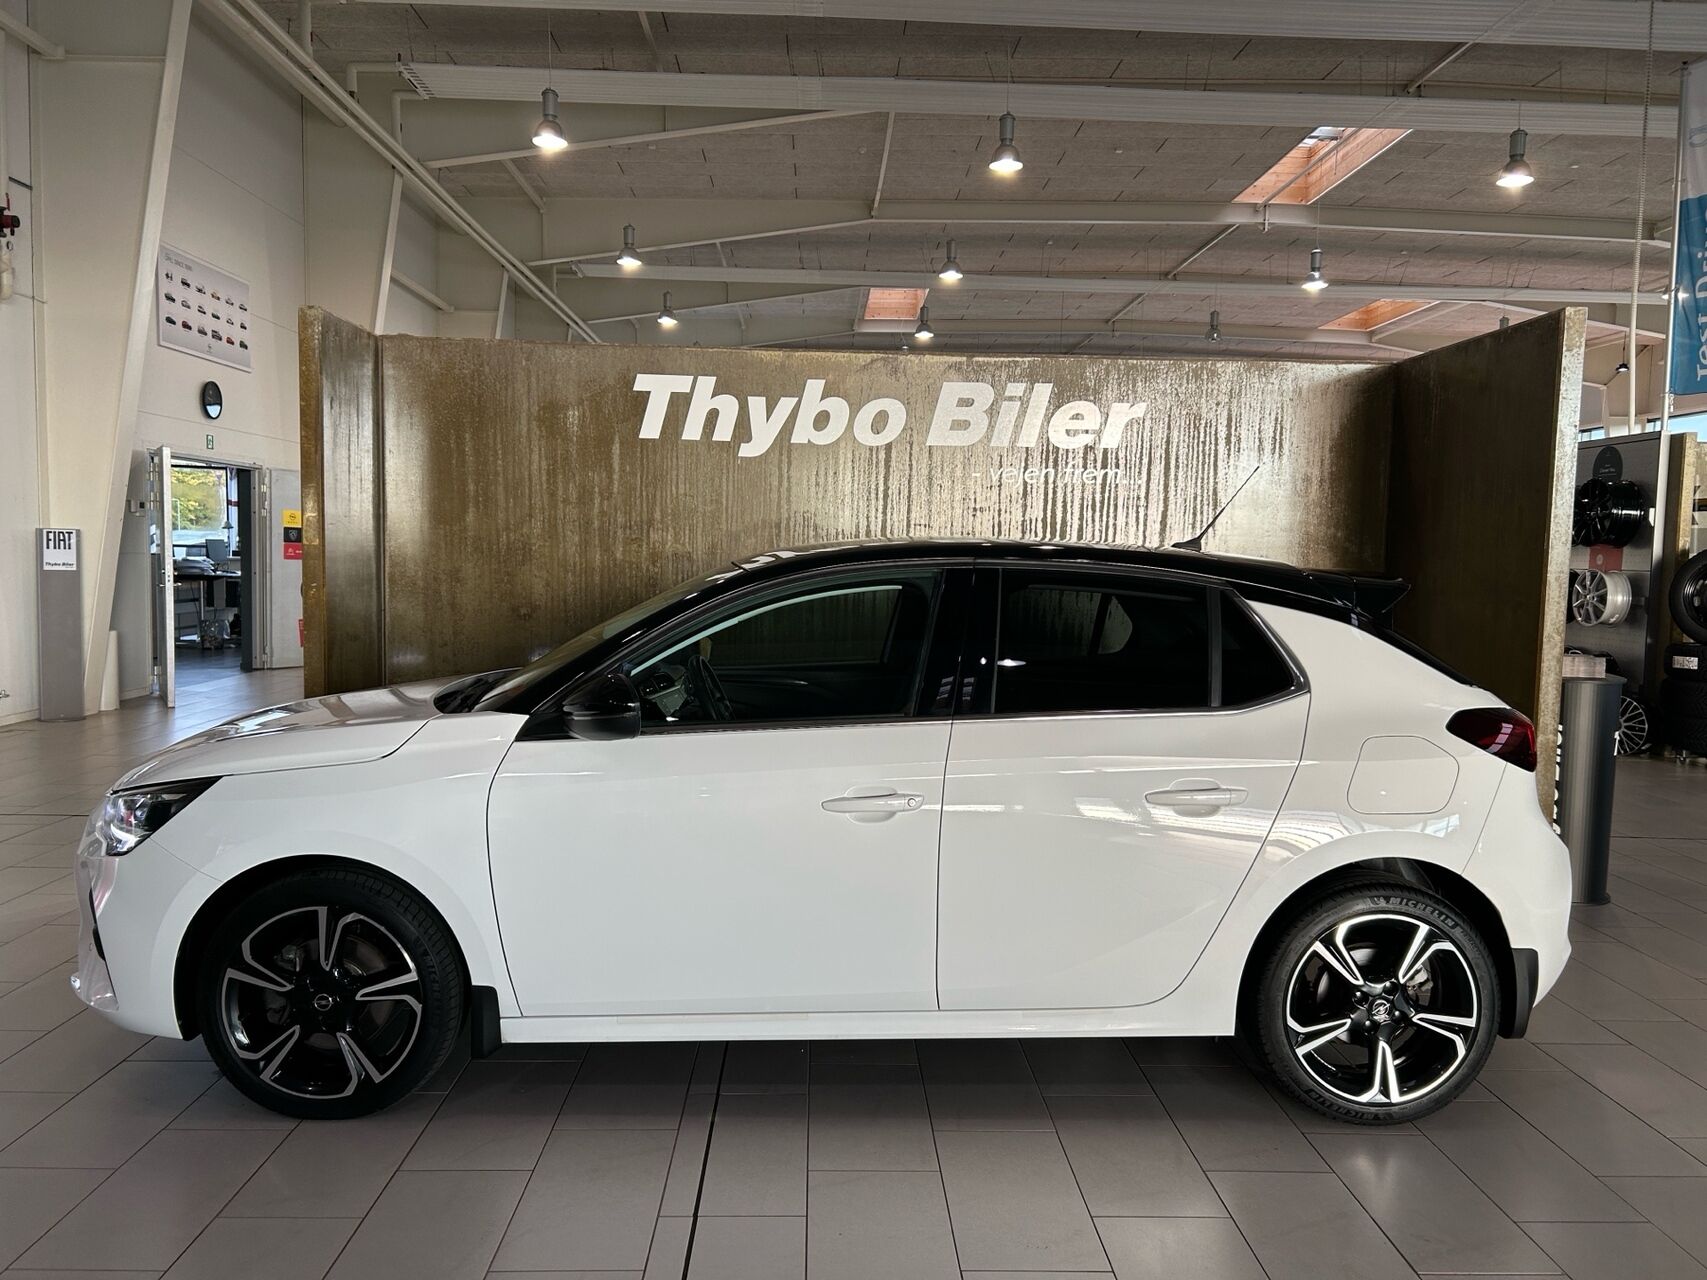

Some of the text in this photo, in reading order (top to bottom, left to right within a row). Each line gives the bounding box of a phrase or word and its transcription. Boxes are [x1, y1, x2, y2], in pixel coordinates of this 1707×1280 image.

[632, 373, 1149, 458] Thybo Biler
[989, 463, 1056, 488] vejen
[46, 531, 73, 550] FIAT
[1389, 896, 1455, 927] MICHELIN
